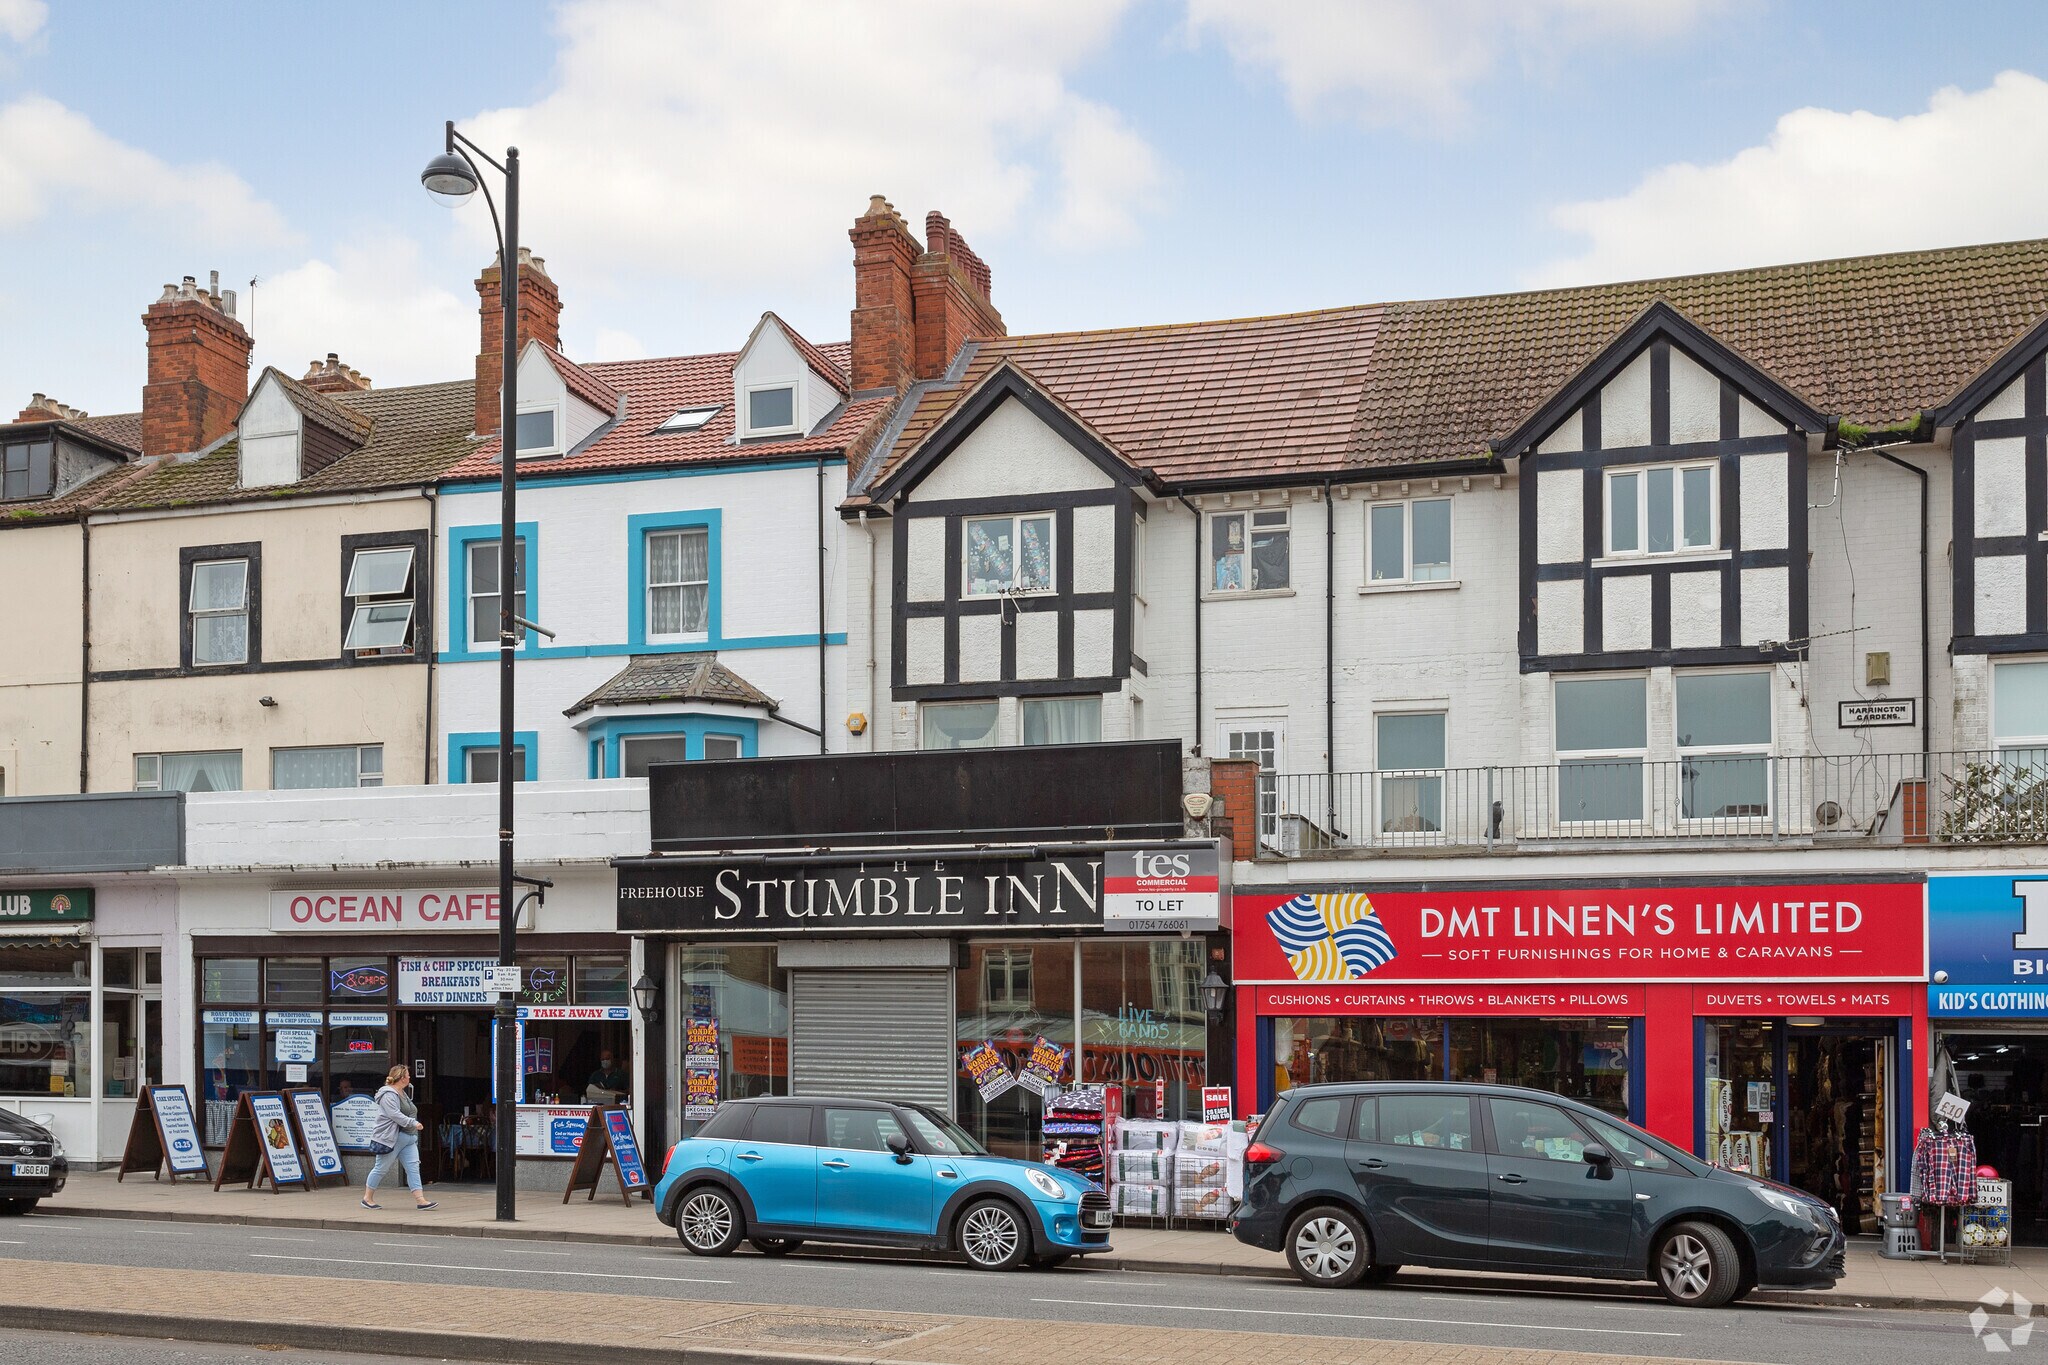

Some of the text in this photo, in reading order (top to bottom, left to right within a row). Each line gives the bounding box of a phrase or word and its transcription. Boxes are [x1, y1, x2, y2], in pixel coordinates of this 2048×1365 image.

[1849, 706, 1906, 714] HARRINGTON
[1132, 850, 1190, 878] tes
[620, 861, 1102, 919] FREEHOUSE STUMBLE INN
[290, 893, 501, 923] OCEAN CAFE
[1136, 900, 1184, 911] TO LET
[1129, 920, 1188, 929] 01754 766061
[1421, 901, 1863, 939] DMT LINEN'S LIMITED
[1448, 946, 1833, 960] SOFT FURNISHINGS FOR HOME & CARAVANS
[401, 960, 421, 971] FISH
[423, 961, 431, 971] &
[432, 960, 455, 971] CHIP
[2013, 959, 2048, 974] BI
[346, 973, 386, 987] & CHIPS
[421, 976, 480, 987] BREAKFASTS
[414, 991, 487, 1002] ROAST DINNERS
[1269, 993, 1628, 1005] CUSHIONS CURTAINS THROWS BLANKETS PILLOWS
[1707, 993, 1890, 1006] DUVETS TOWELS MATS
[1939, 992, 2048, 1010] KID'S CLOTHIN
[533, 1008, 603, 1018] TAKE AWAY
[687, 1028, 717, 1036] WONDER
[1118, 1022, 1170, 1040] BANDS
[689, 1035, 716, 1043] CIRCUS
[349, 1041, 373, 1051] OPEN
[967, 1048, 997, 1071] WONDER
[1033, 1045, 1064, 1066] WONDER
[972, 1055, 999, 1077] CIRCUS
[1031, 1053, 1060, 1073] CIRCUS
[687, 1078, 717, 1086] WONDER
[689, 1085, 716, 1093] CIRCUS
[1206, 1094, 1228, 1102] SALE
[547, 1109, 567, 1117] TAKE
[1940, 1101, 1964, 1119] £10
[565, 1120, 585, 1129] Specials
[174, 1141, 191, 1149] £3.25
[17, 1166, 35, 1175] YJ60
[1978, 1195, 2003, 1204] 3.99
